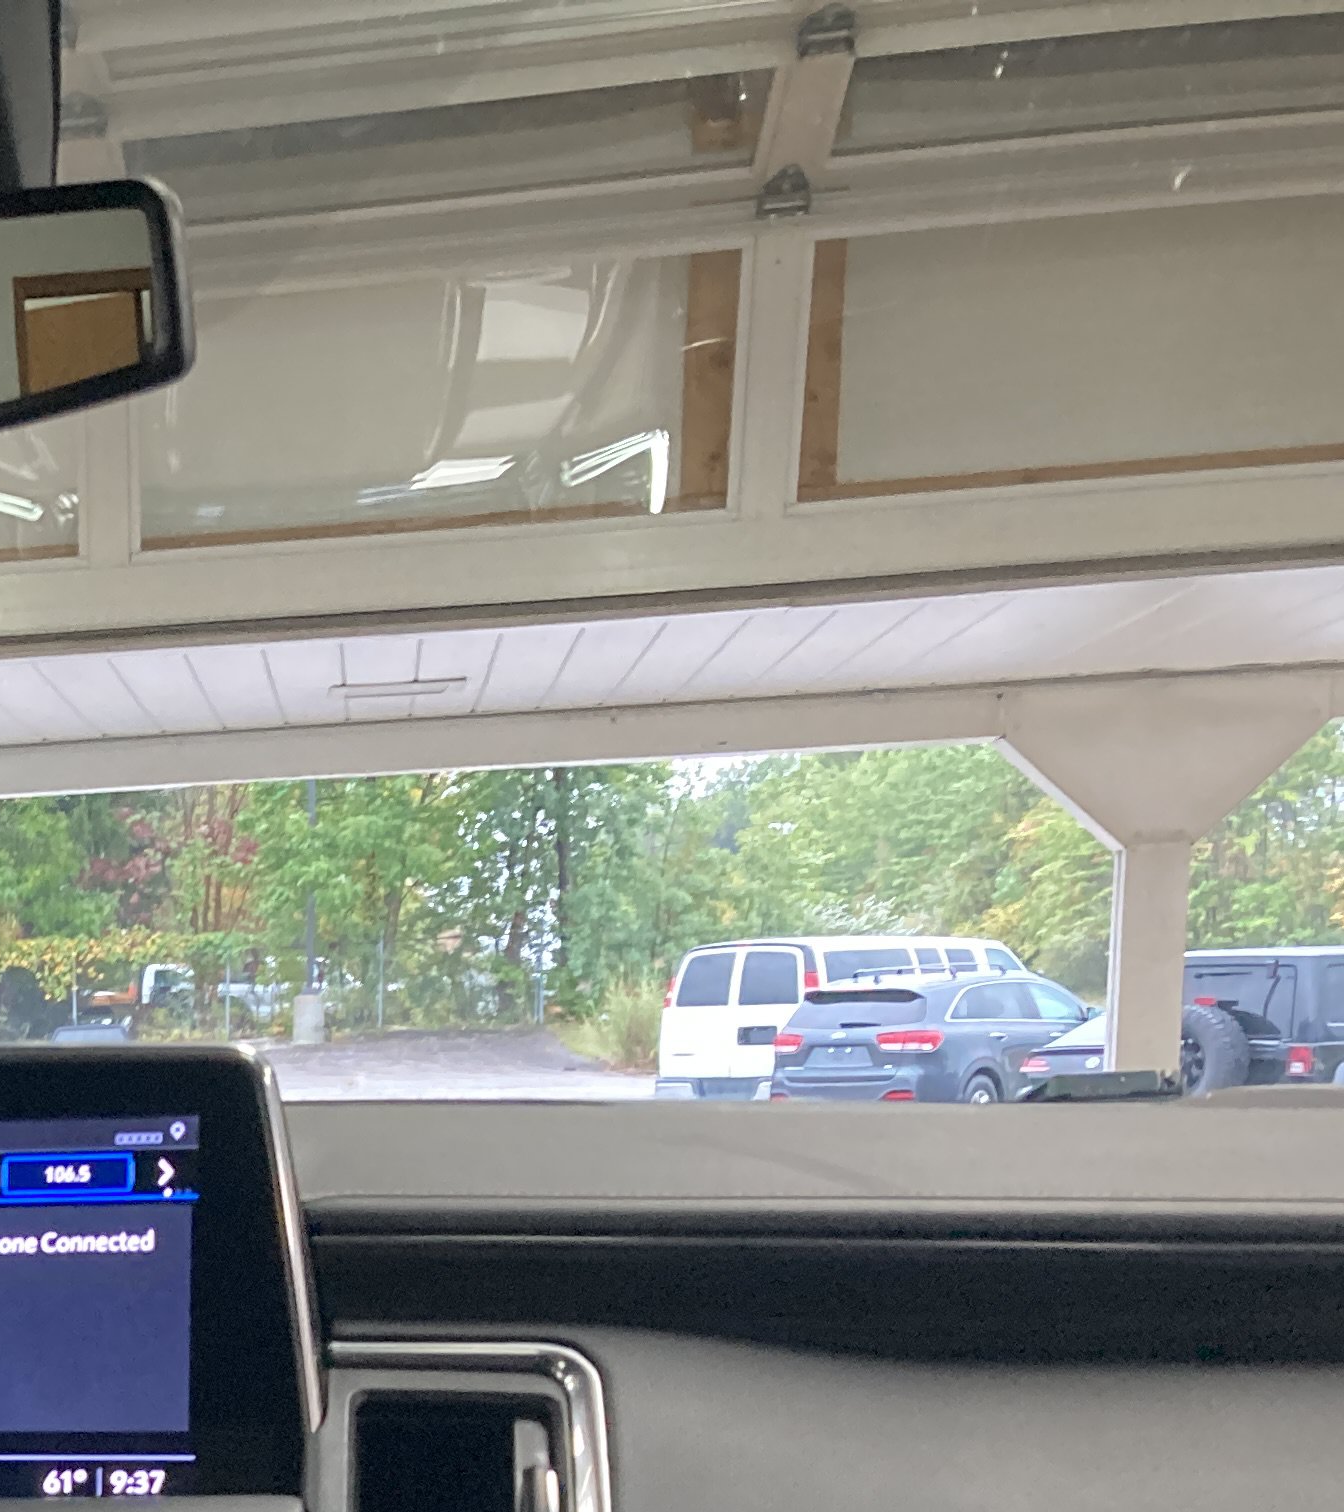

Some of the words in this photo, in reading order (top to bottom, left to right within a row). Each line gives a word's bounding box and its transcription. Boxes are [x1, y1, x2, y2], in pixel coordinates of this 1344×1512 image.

[44, 1163, 92, 1184] 106.5
[40, 1228, 156, 1254] Connected
[42, 1468, 89, 1495] 61°
[109, 1469, 166, 1495] 9:37
